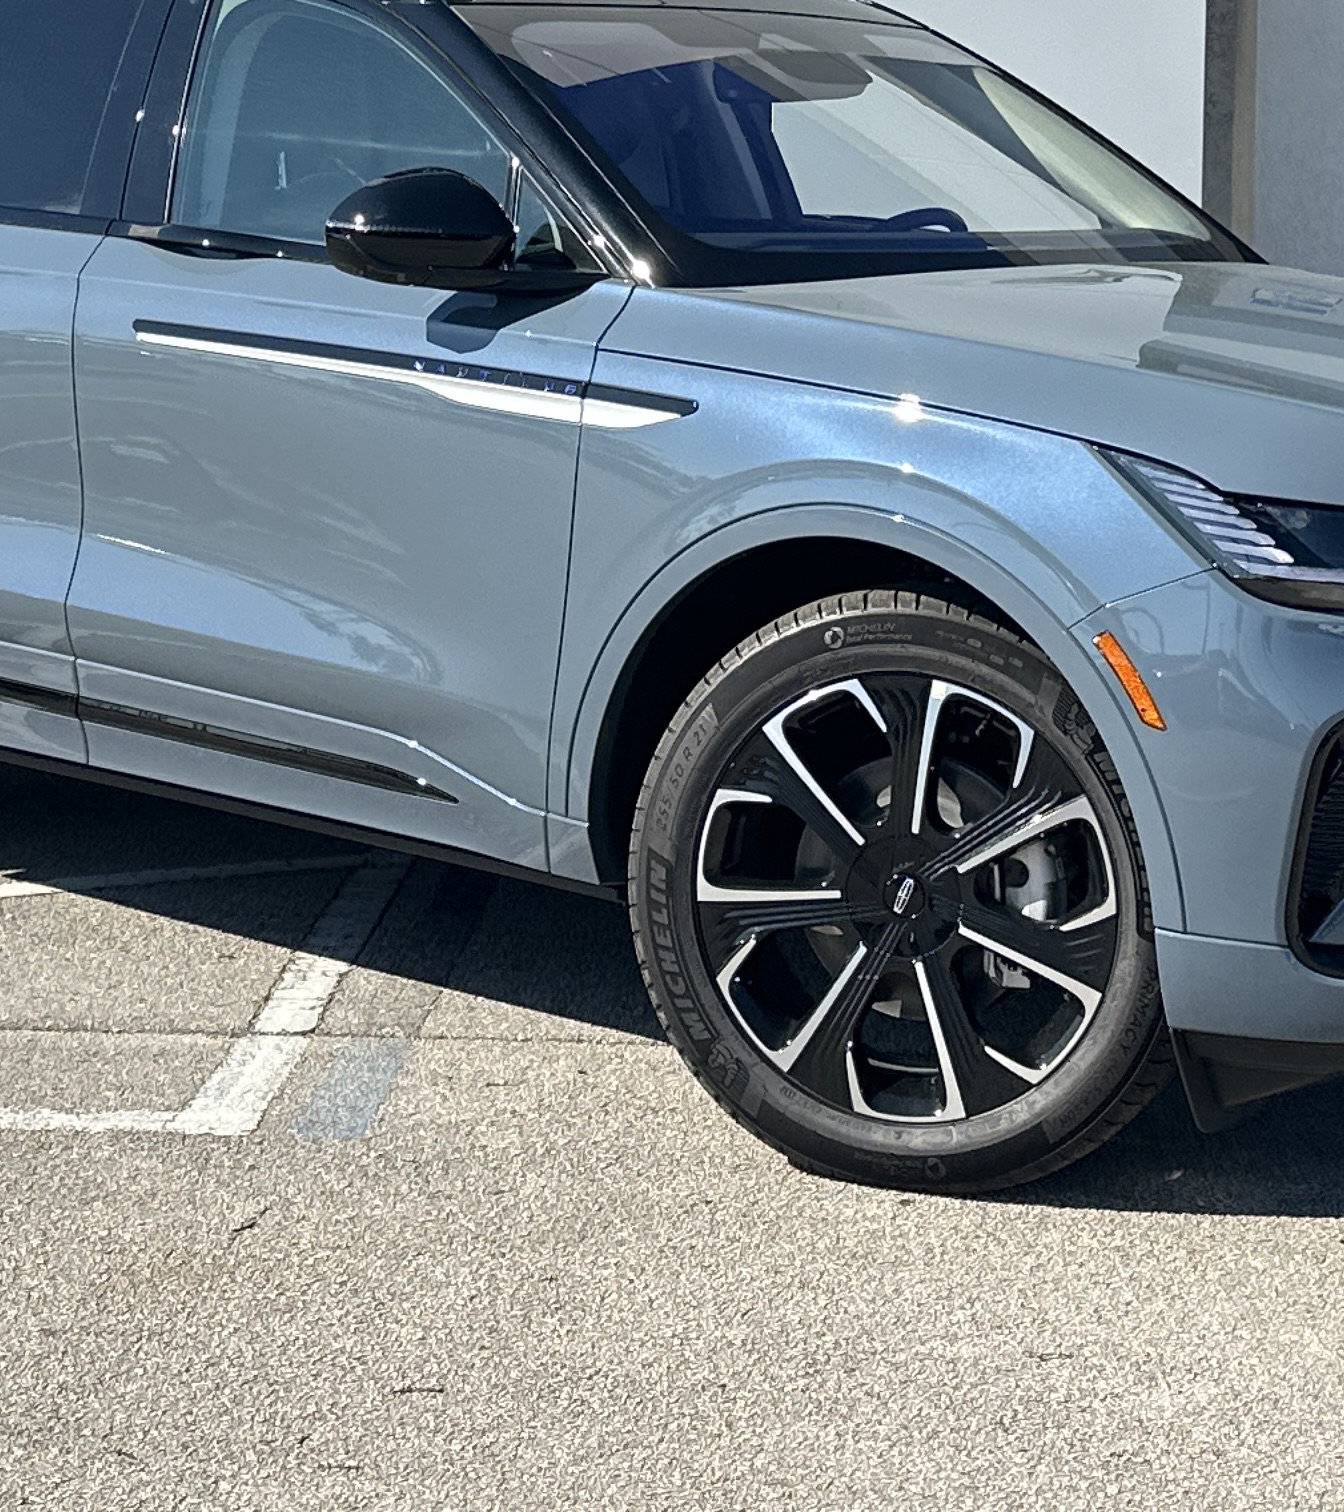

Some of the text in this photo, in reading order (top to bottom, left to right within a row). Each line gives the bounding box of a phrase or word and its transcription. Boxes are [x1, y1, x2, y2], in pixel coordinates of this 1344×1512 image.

[413, 359, 577, 395] NAUTILUS
[682, 746, 694, 762] R
[649, 857, 712, 1041] MICHELIN
[1120, 966, 1156, 1057] PRIMACY
